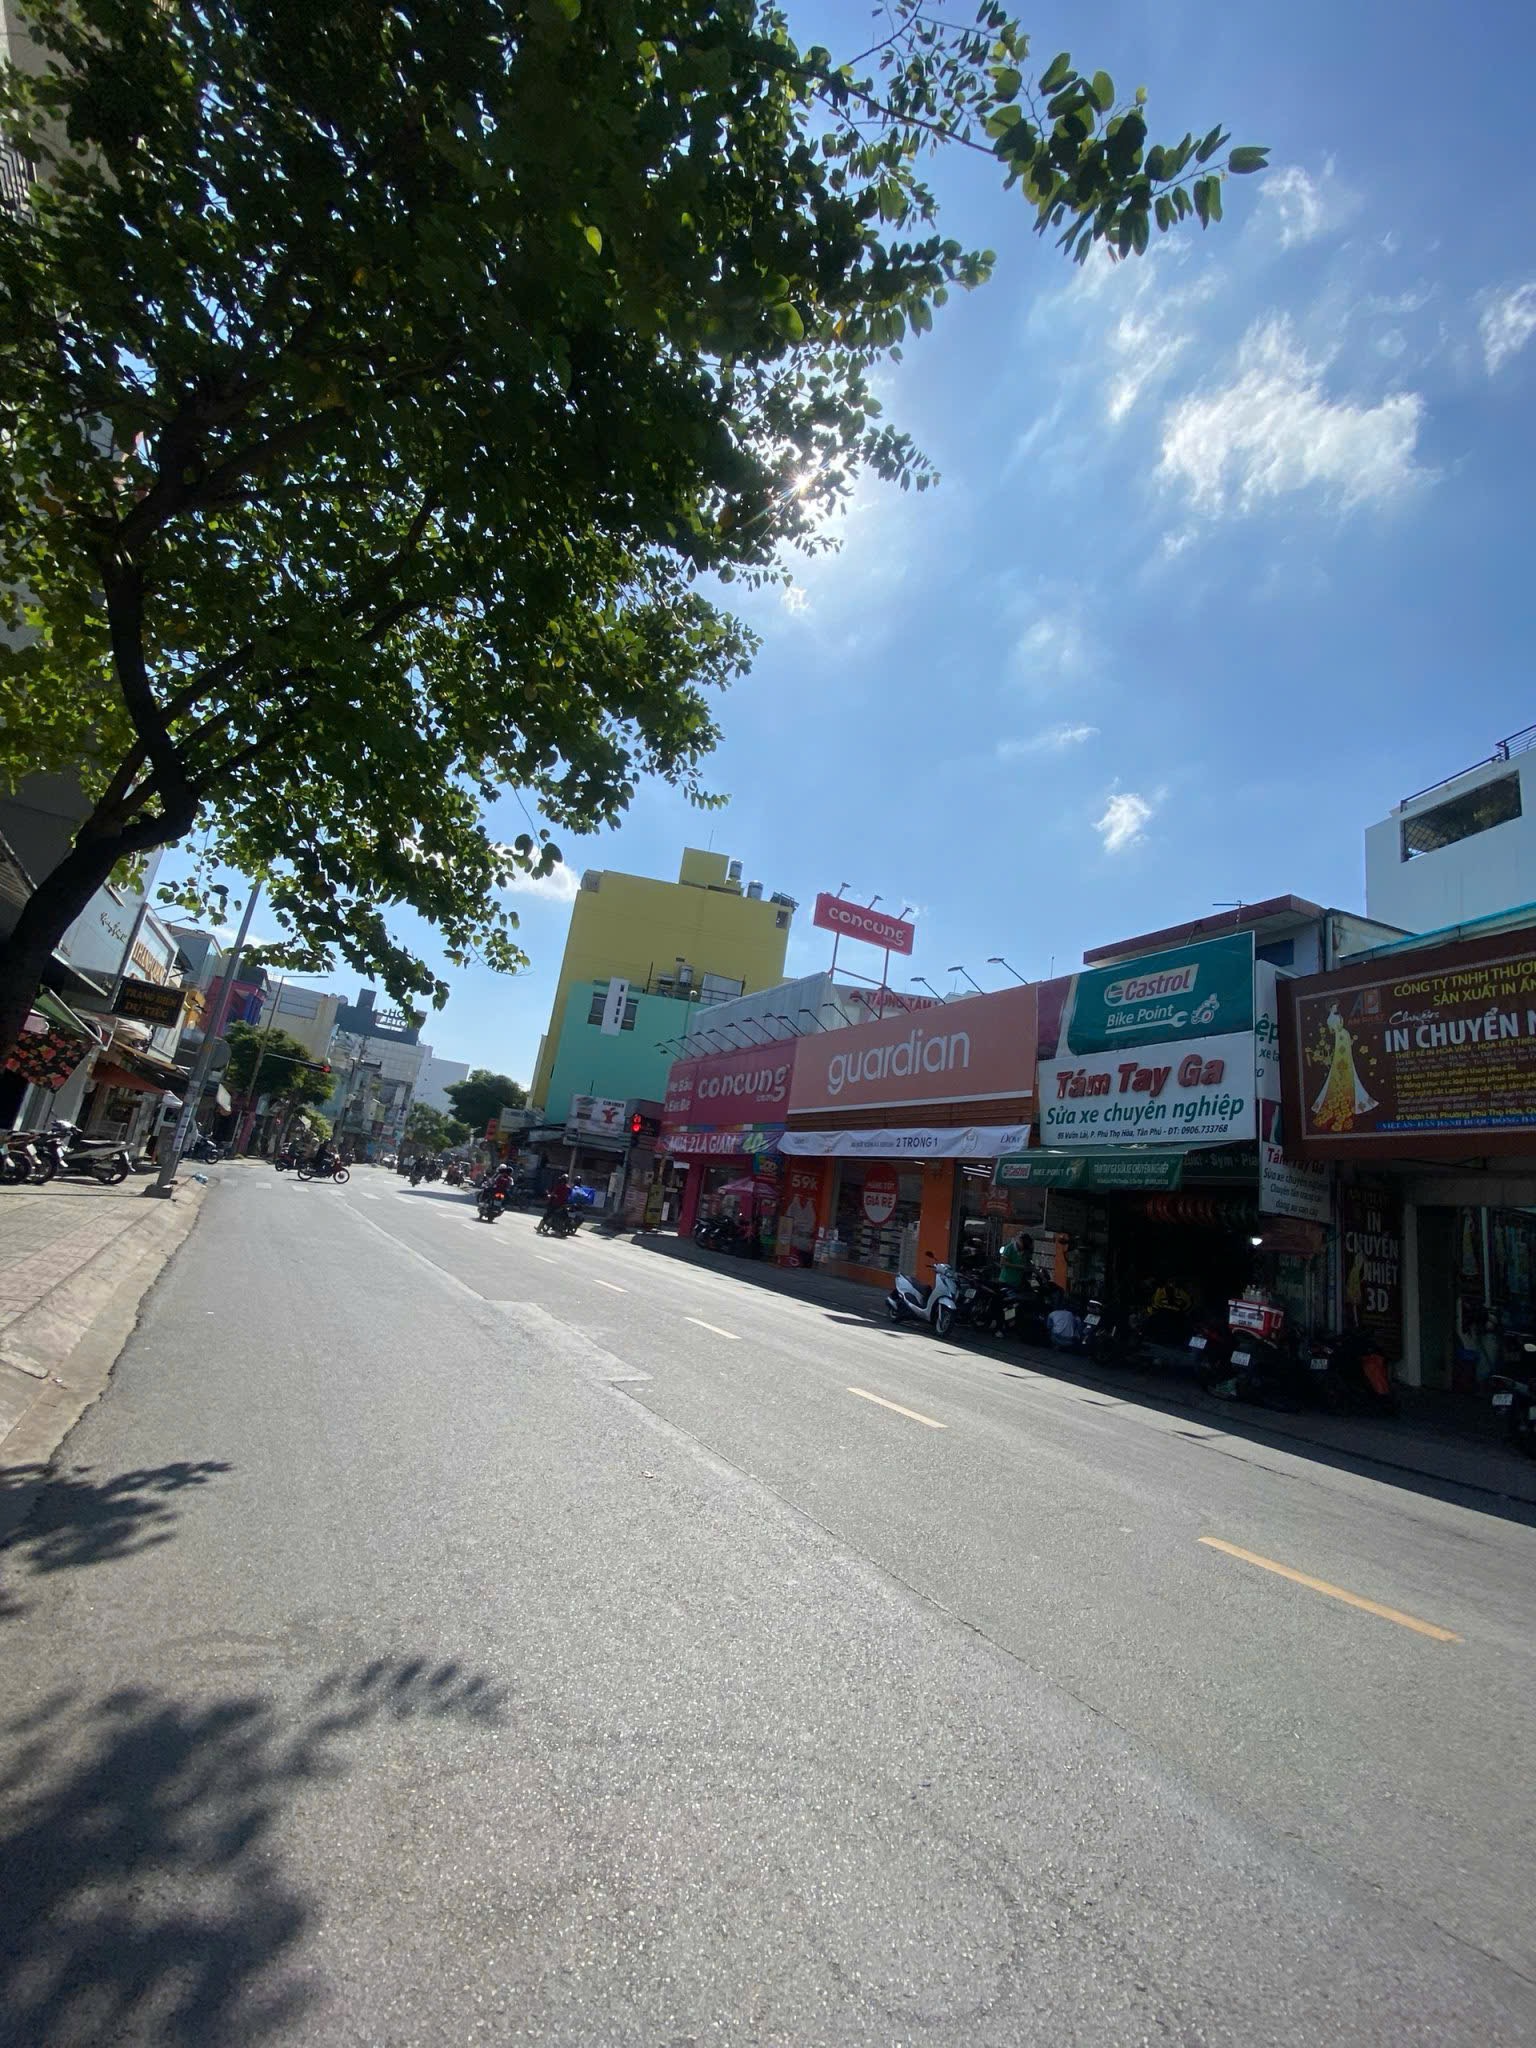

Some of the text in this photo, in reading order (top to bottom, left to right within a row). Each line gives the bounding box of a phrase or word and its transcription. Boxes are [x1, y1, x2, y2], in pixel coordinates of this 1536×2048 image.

[1125, 970, 1190, 1001] Castrol
[1394, 960, 1536, 997] CÔNG TY TNHH THƯƠ
[1502, 982, 1516, 995] IN
[1107, 1004, 1174, 1027] Bike Point
[1385, 1028, 1409, 1053] IN
[1416, 1007, 1519, 1049] CHUYỂN
[827, 1028, 970, 1095] guardian
[1057, 1054, 1224, 1099] Tám Tay Ga
[698, 1065, 786, 1102] concung
[1047, 1093, 1244, 1126] Sửa xe chuyên nghiệp
[896, 1138, 902, 1148] 2
[903, 1137, 932, 1148] TRONG
[934, 1136, 938, 1147] 1
[1367, 1210, 1381, 1233] IN
[1366, 1287, 1390, 1313] 3D
